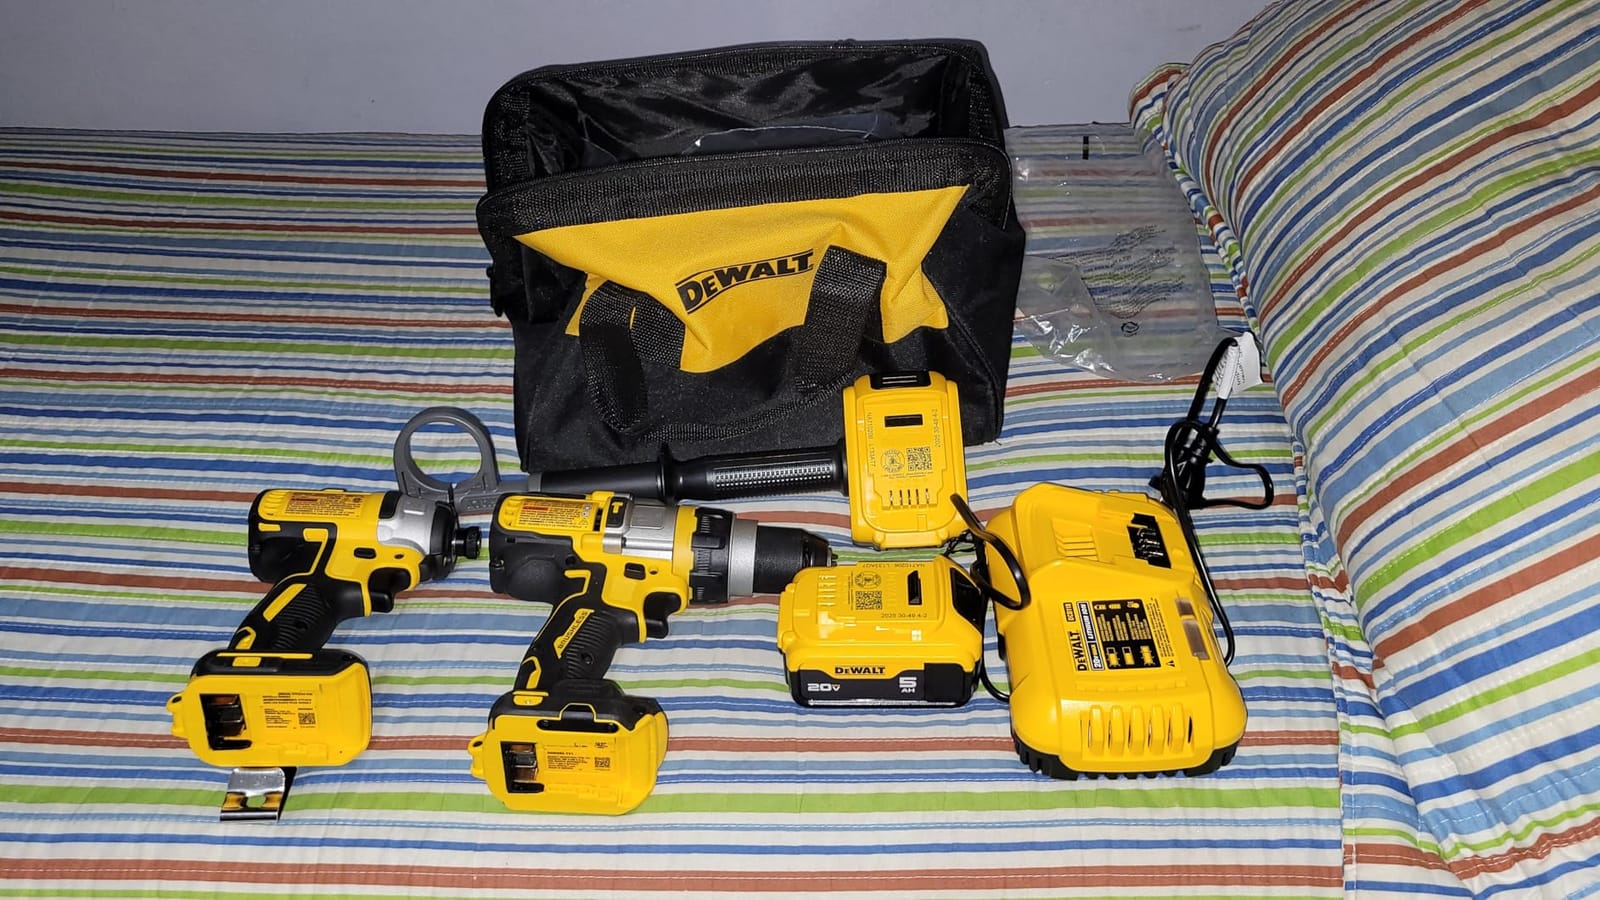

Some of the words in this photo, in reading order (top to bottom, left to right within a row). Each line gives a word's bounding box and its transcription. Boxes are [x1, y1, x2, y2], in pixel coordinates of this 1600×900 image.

[676, 249, 814, 312] DEWALT
[1080, 603, 1089, 615] ION
[557, 610, 588, 649] BRUSHLESS
[1082, 615, 1095, 640] LITHIUM
[1069, 631, 1087, 671] DEWALT
[834, 666, 886, 675] DEWALT
[899, 676, 917, 688] 5
